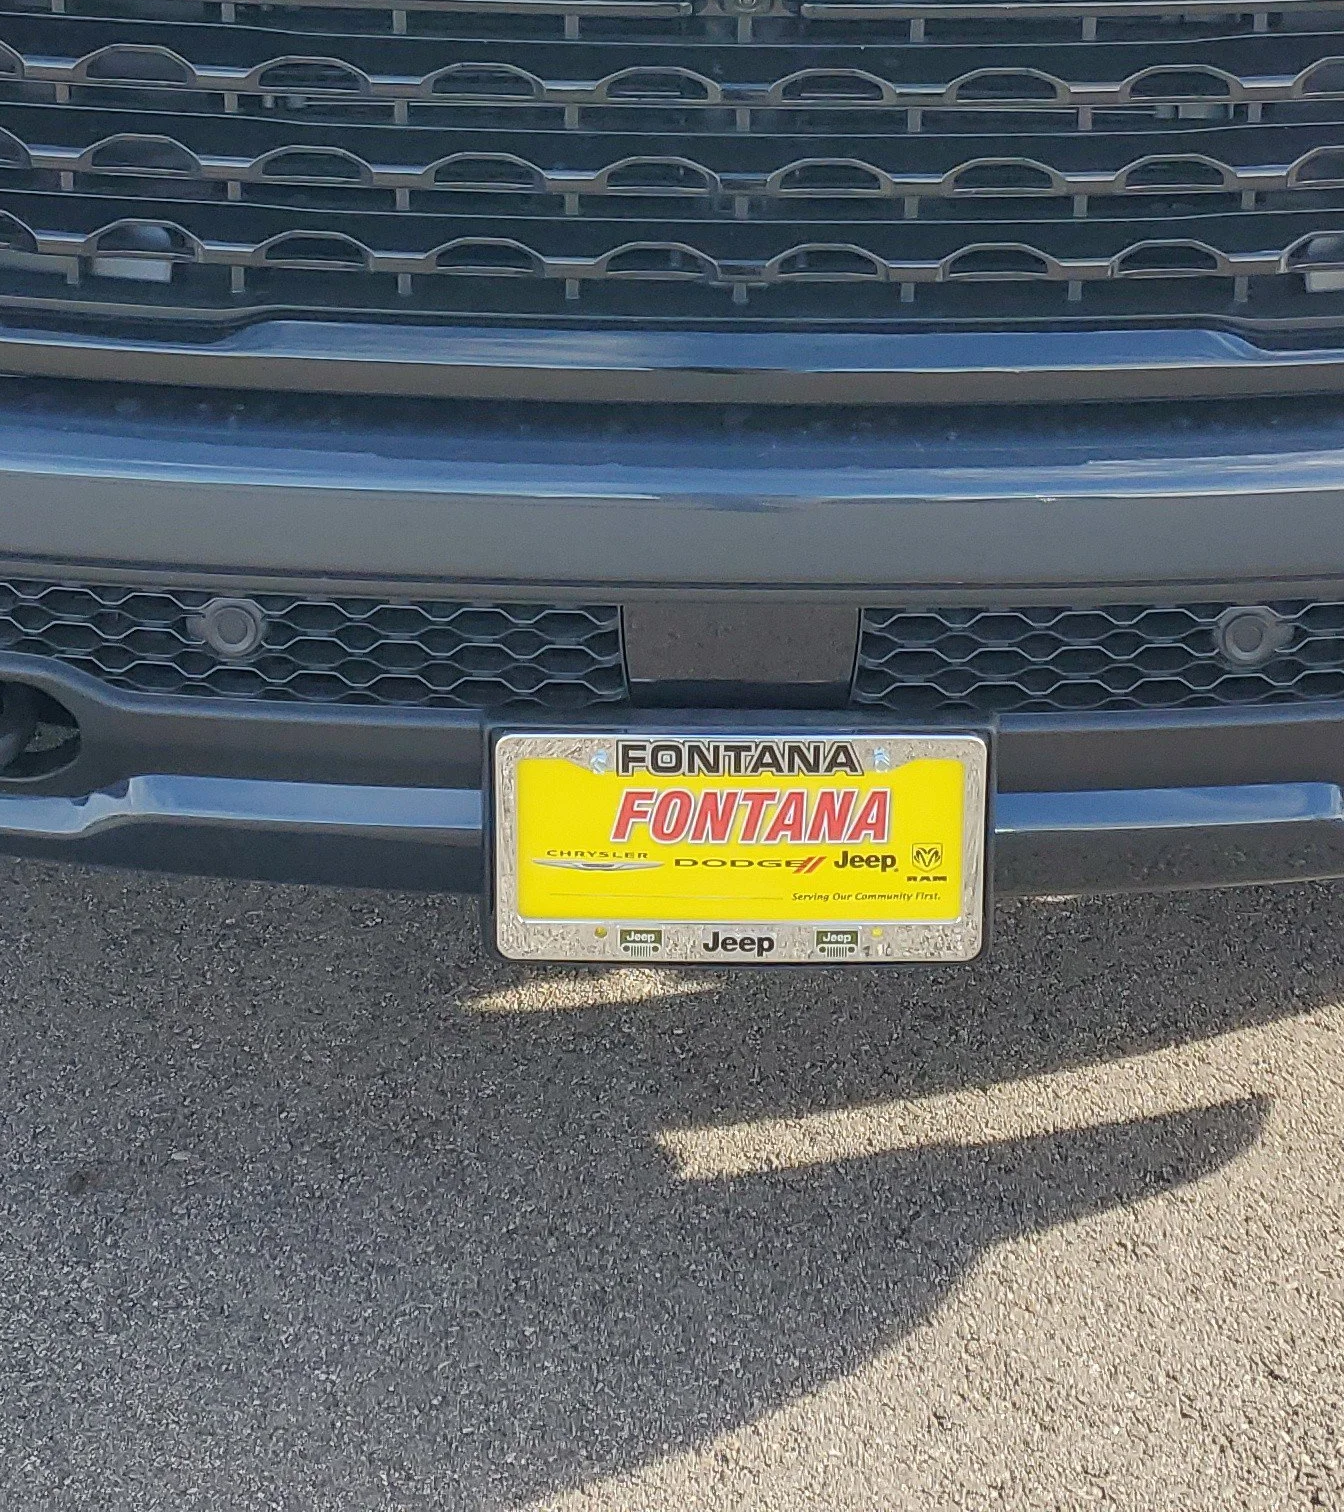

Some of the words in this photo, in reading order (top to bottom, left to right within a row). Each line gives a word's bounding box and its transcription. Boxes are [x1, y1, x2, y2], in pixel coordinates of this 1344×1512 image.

[616, 739, 864, 777] FONTANA
[609, 788, 891, 844] FONTANA
[546, 849, 649, 859] CHRYSLER
[674, 858, 808, 869] DODGE
[834, 851, 897, 873] Jeep
[791, 892, 829, 902] Serving
[832, 892, 852, 901] Our
[854, 892, 913, 901] Community
[626, 930, 655, 942] Jeep
[822, 932, 852, 944] Jeep
[702, 931, 775, 957] Jeep
